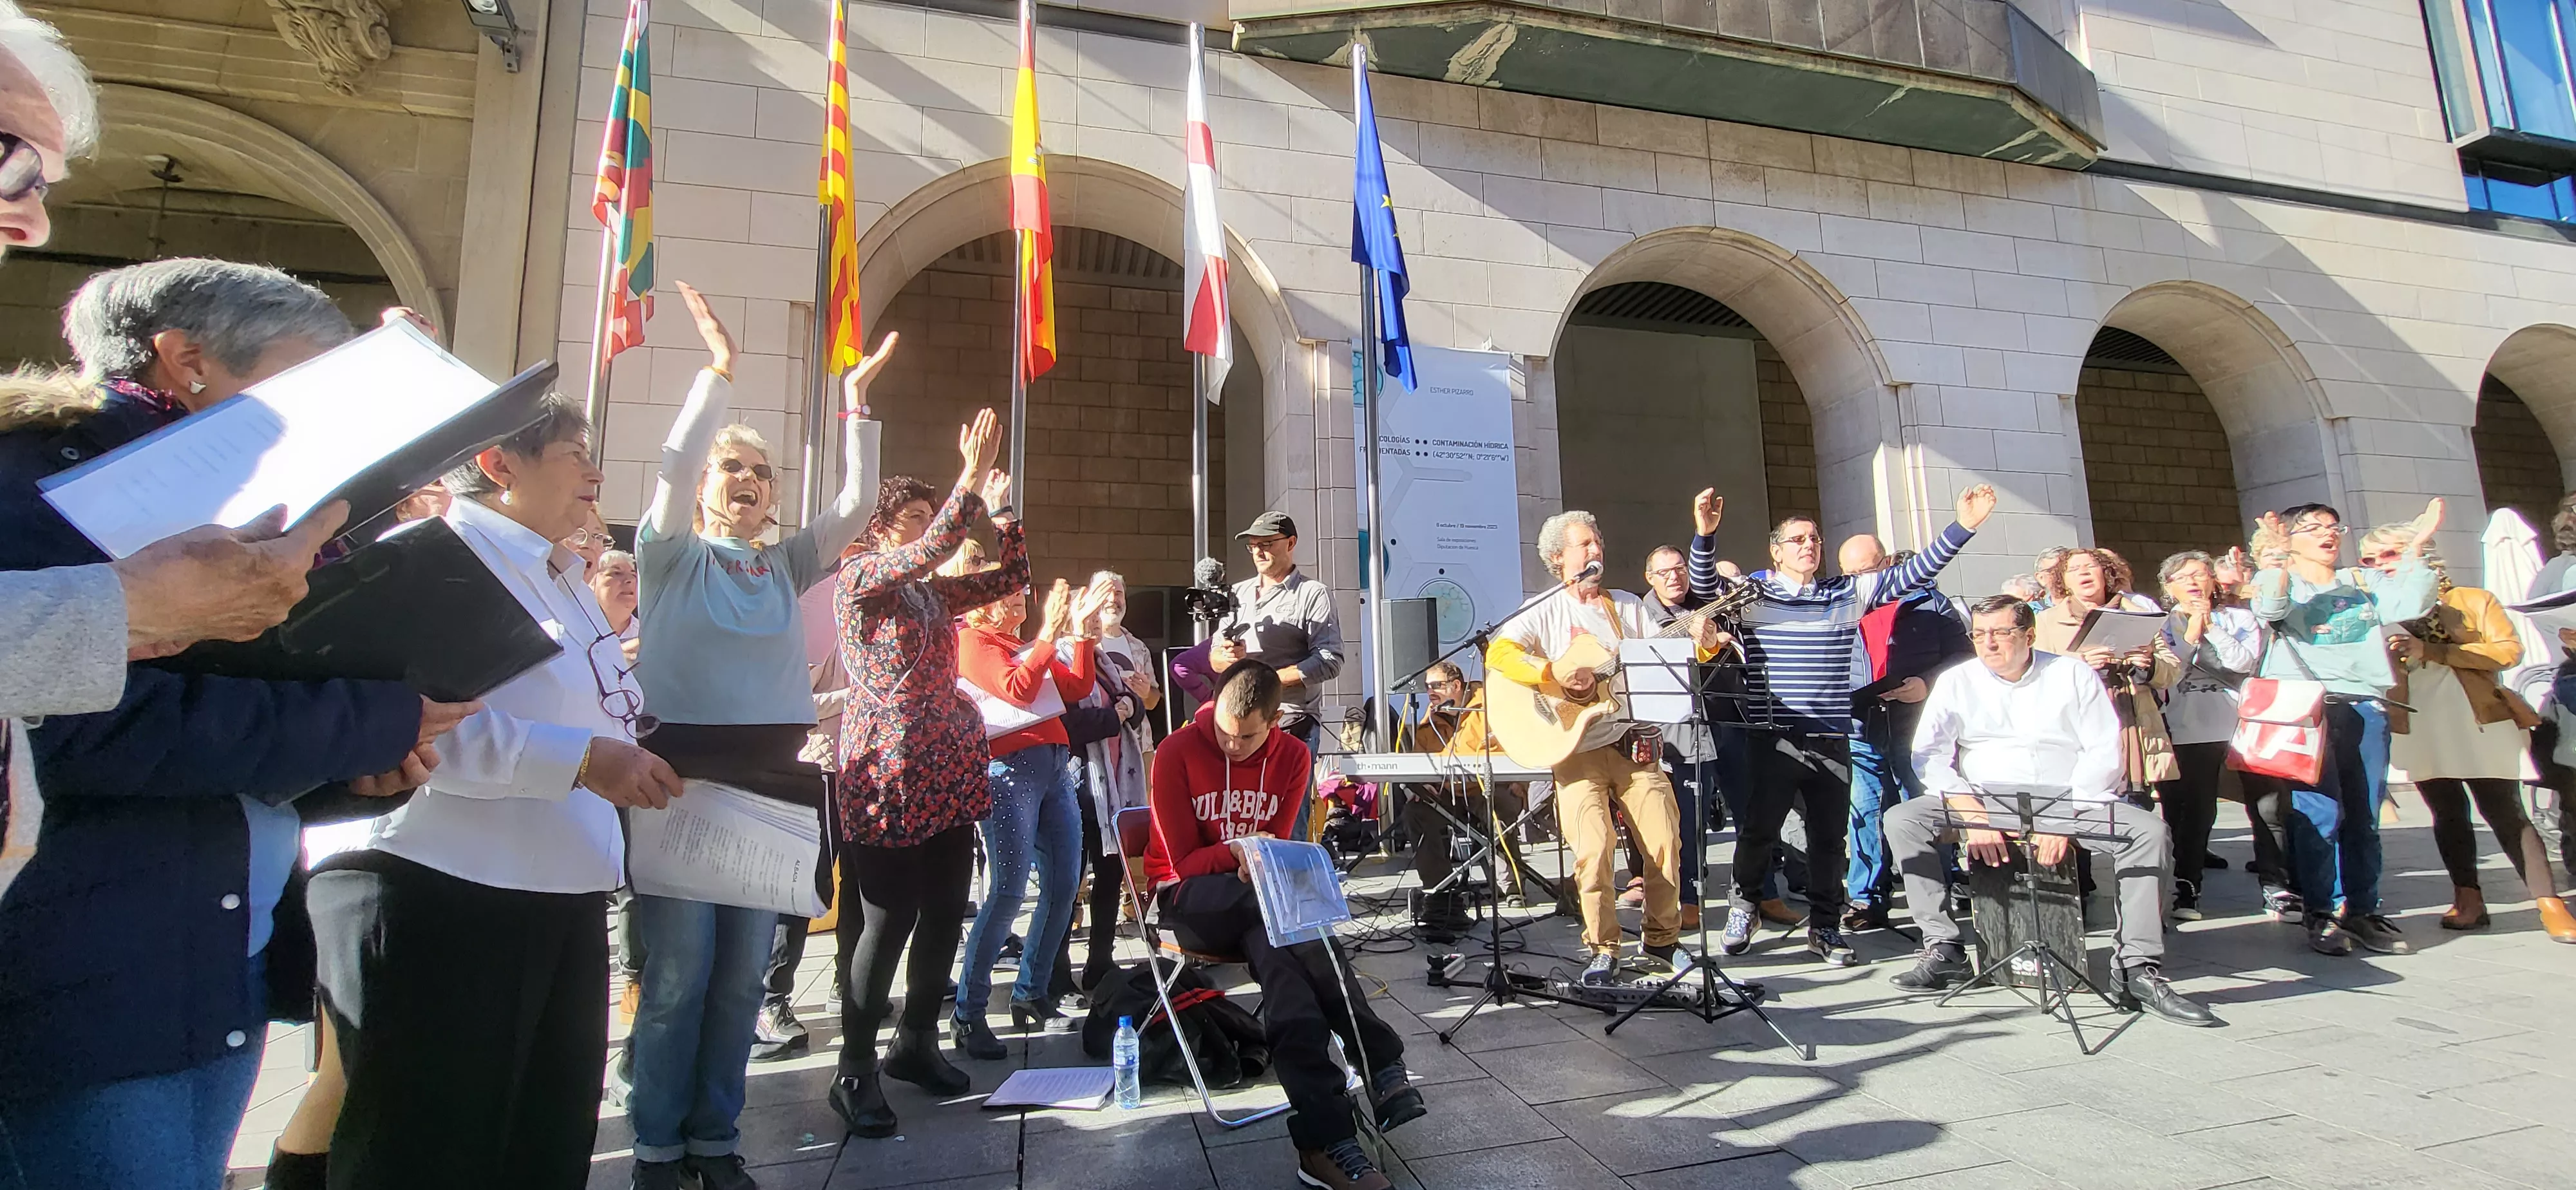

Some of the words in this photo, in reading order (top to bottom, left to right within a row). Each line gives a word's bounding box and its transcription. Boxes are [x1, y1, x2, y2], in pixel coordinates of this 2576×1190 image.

[1379, 435, 1410, 444] COLOGÍAS
[1432, 439, 1482, 449] CONTAMINACIÓN
[1484, 441, 1509, 449] HÍDRICA
[1191, 789, 1284, 821] ULL&BEA
